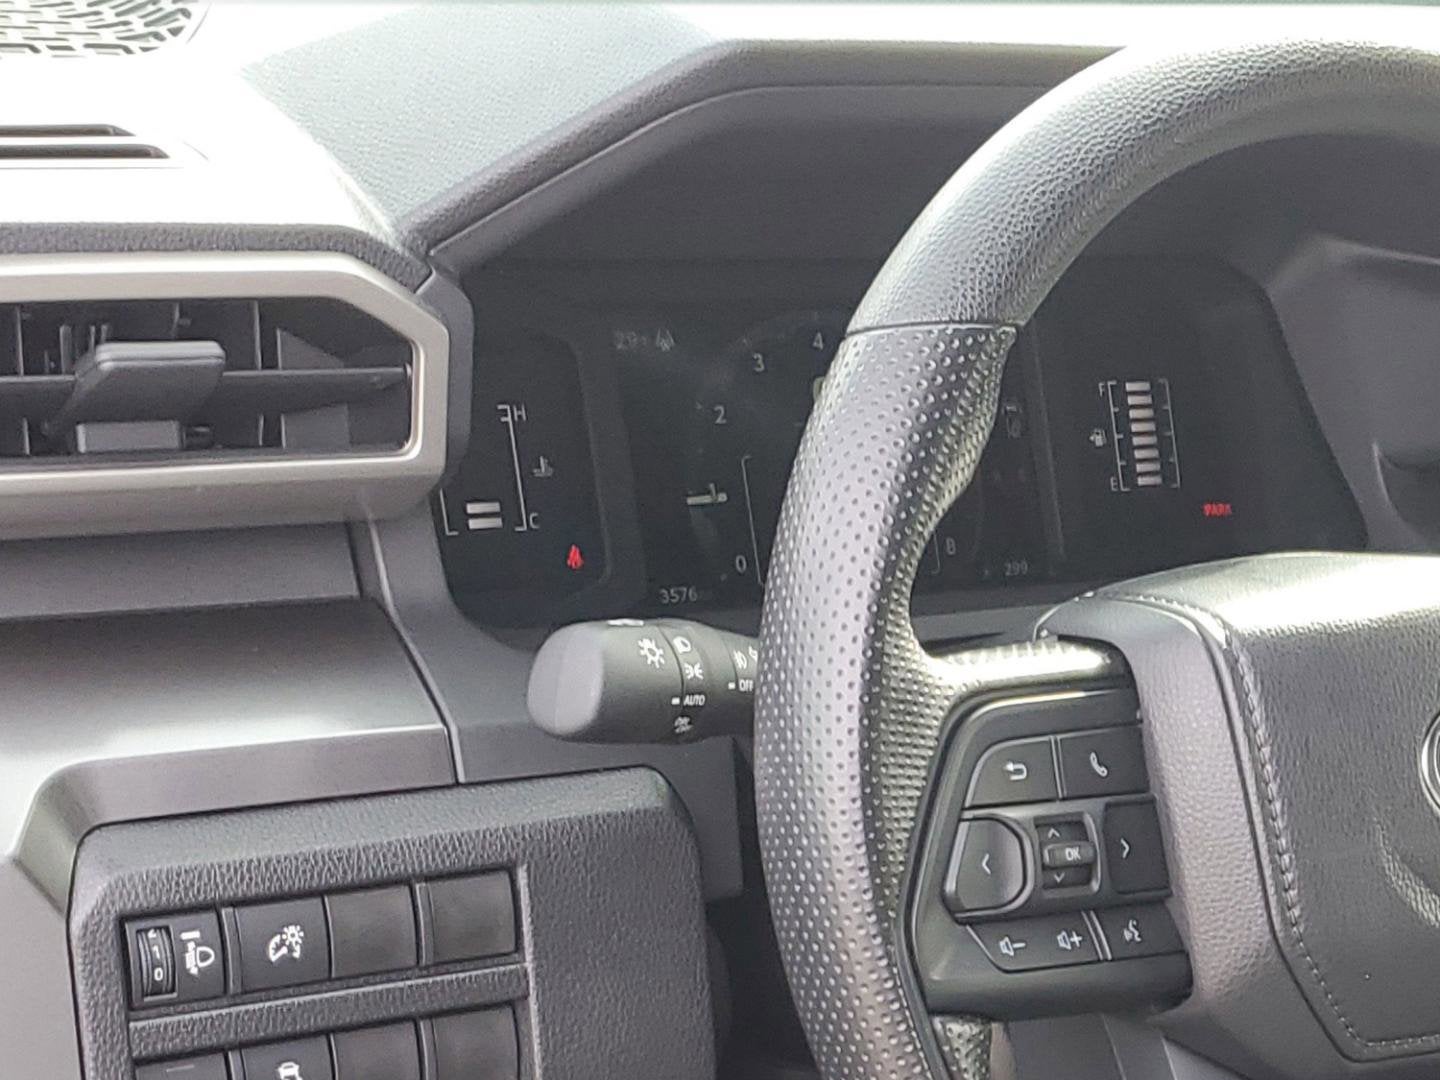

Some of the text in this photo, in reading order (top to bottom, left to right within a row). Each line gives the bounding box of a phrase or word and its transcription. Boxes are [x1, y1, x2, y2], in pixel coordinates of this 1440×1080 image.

[813, 332, 825, 350] 4
[752, 354, 766, 373] 3
[512, 404, 527, 422] H
[714, 406, 727, 425] 2
[529, 512, 540, 530] C
[735, 555, 748, 574] 0
[659, 588, 698, 604] 3576
[738, 679, 754, 691] OFF
[683, 694, 706, 706] AUTO
[1064, 847, 1081, 861] OK
[153, 968, 164, 982] 0
